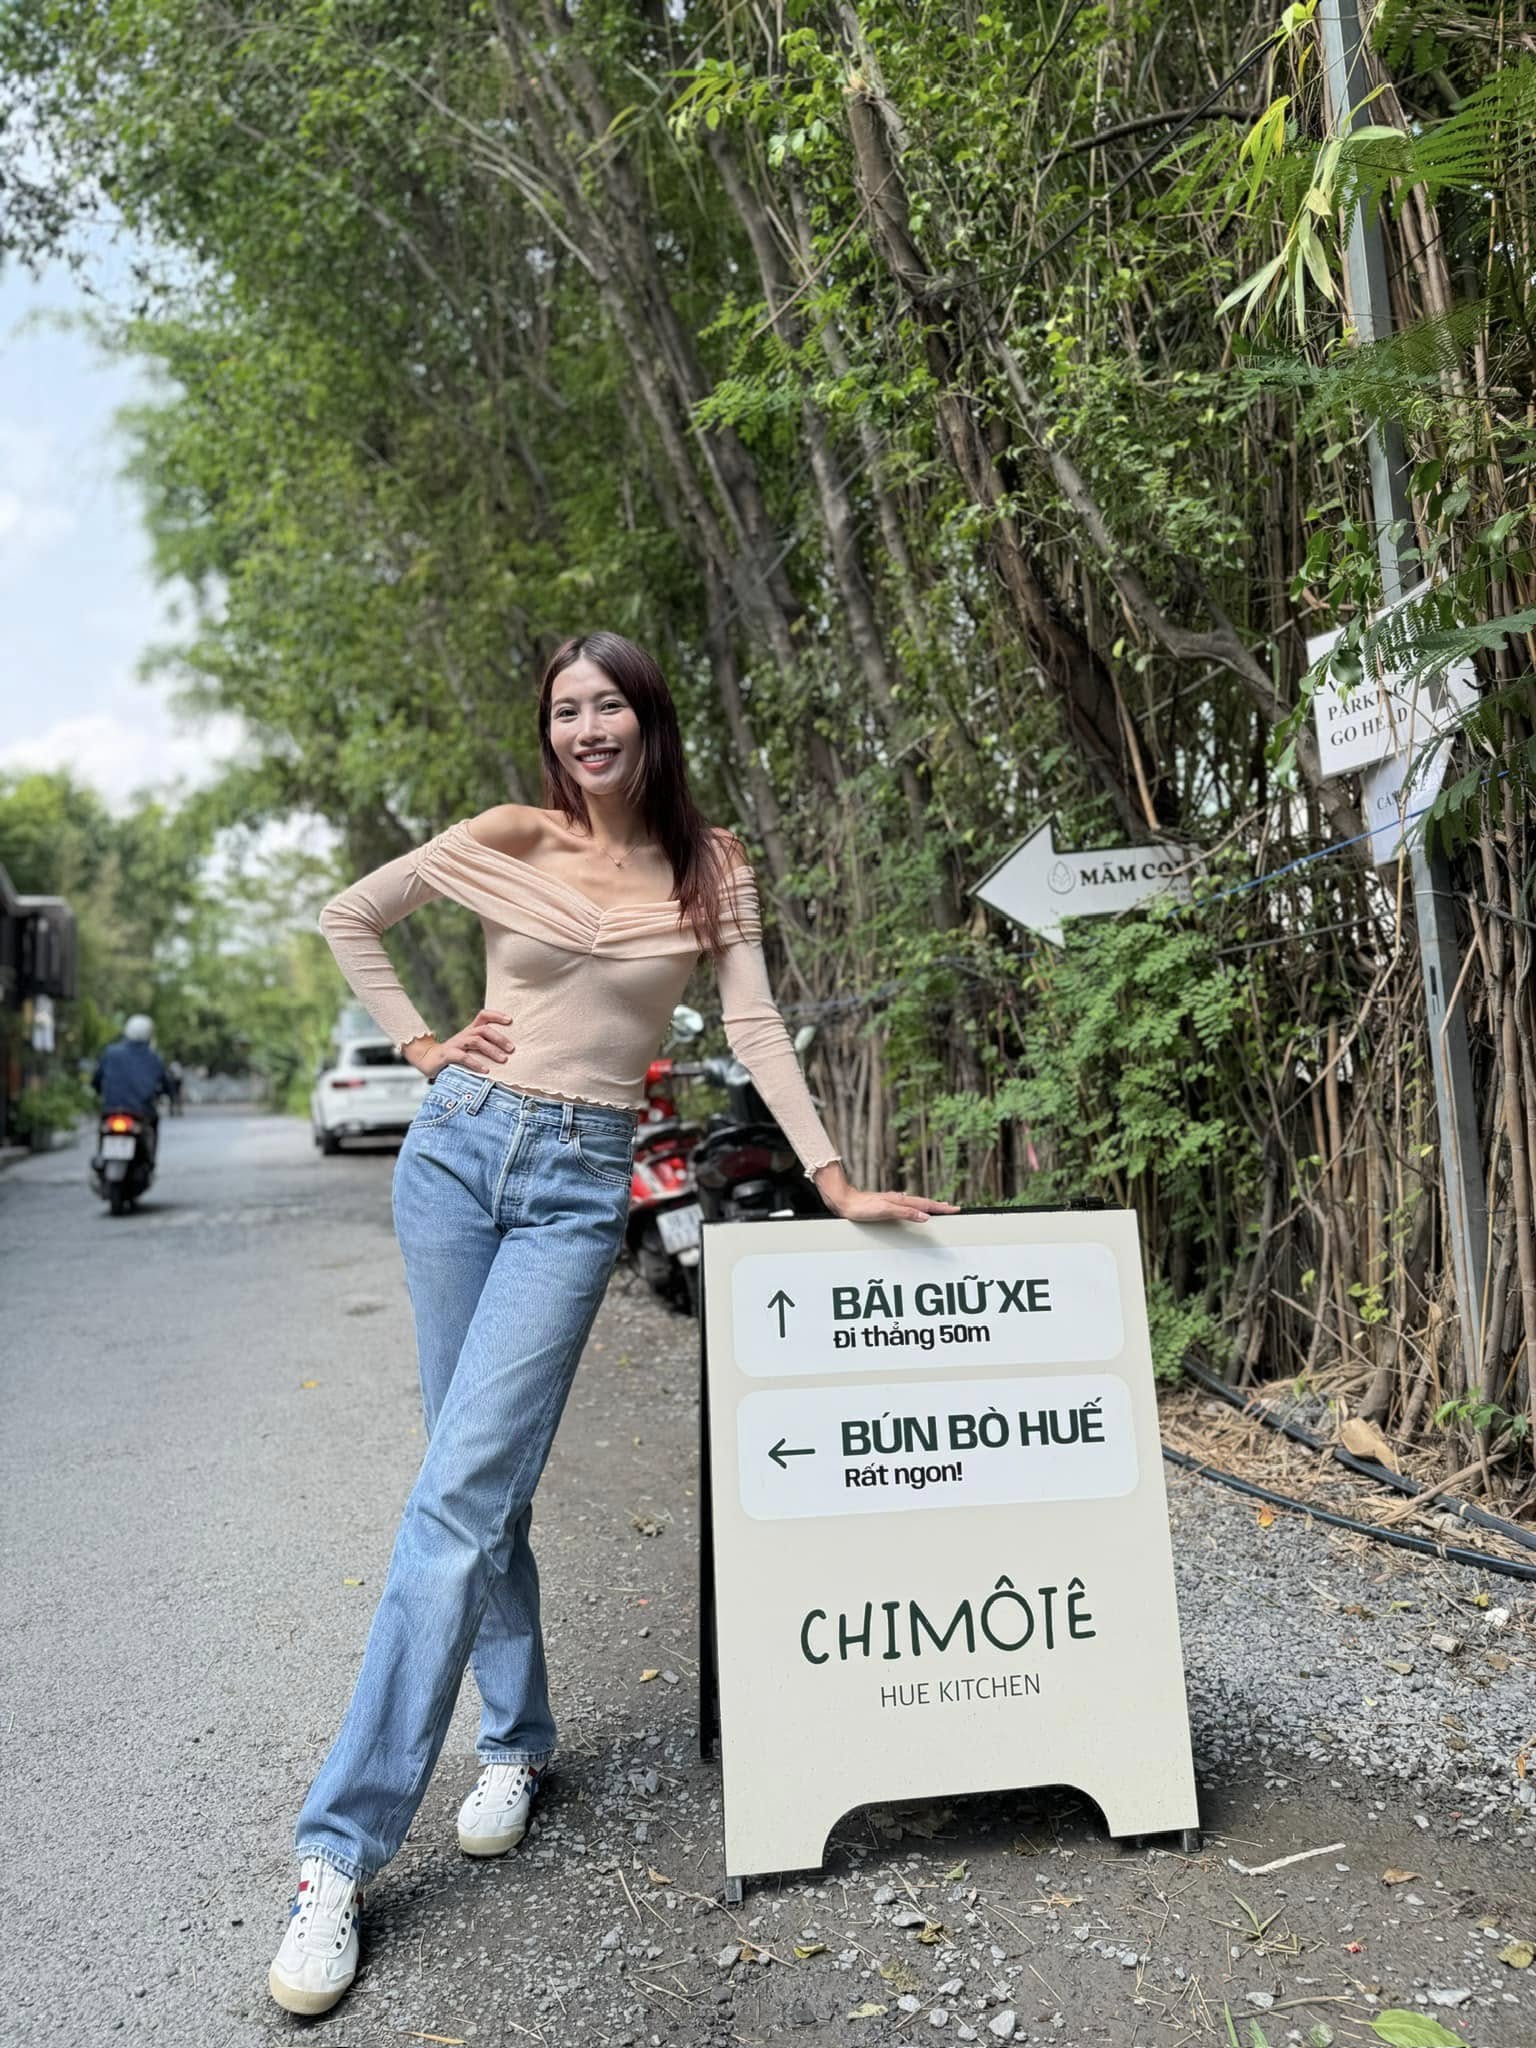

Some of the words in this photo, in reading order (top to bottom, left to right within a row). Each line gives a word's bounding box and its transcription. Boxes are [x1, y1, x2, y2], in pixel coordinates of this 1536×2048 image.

[1331, 726, 1357, 746] GO
[1362, 707, 1408, 736] HED
[832, 1278, 904, 1320] BÃI
[915, 1274, 994, 1318] GIỮ
[996, 1278, 1052, 1314] XE
[833, 1328, 857, 1349] Đi
[861, 1321, 935, 1351] thẳng
[940, 1324, 991, 1344] 50m
[840, 1411, 939, 1457] BÚN
[948, 1407, 1010, 1451] BÒ
[1019, 1397, 1106, 1447] HUẾ
[844, 1462, 889, 1488] Rất
[894, 1461, 963, 1490] ngon!
[800, 1574, 1097, 1665] CHIMÔTÊ
[880, 1683, 930, 1708] HUE
[938, 1673, 1041, 1703] KITCHEN
